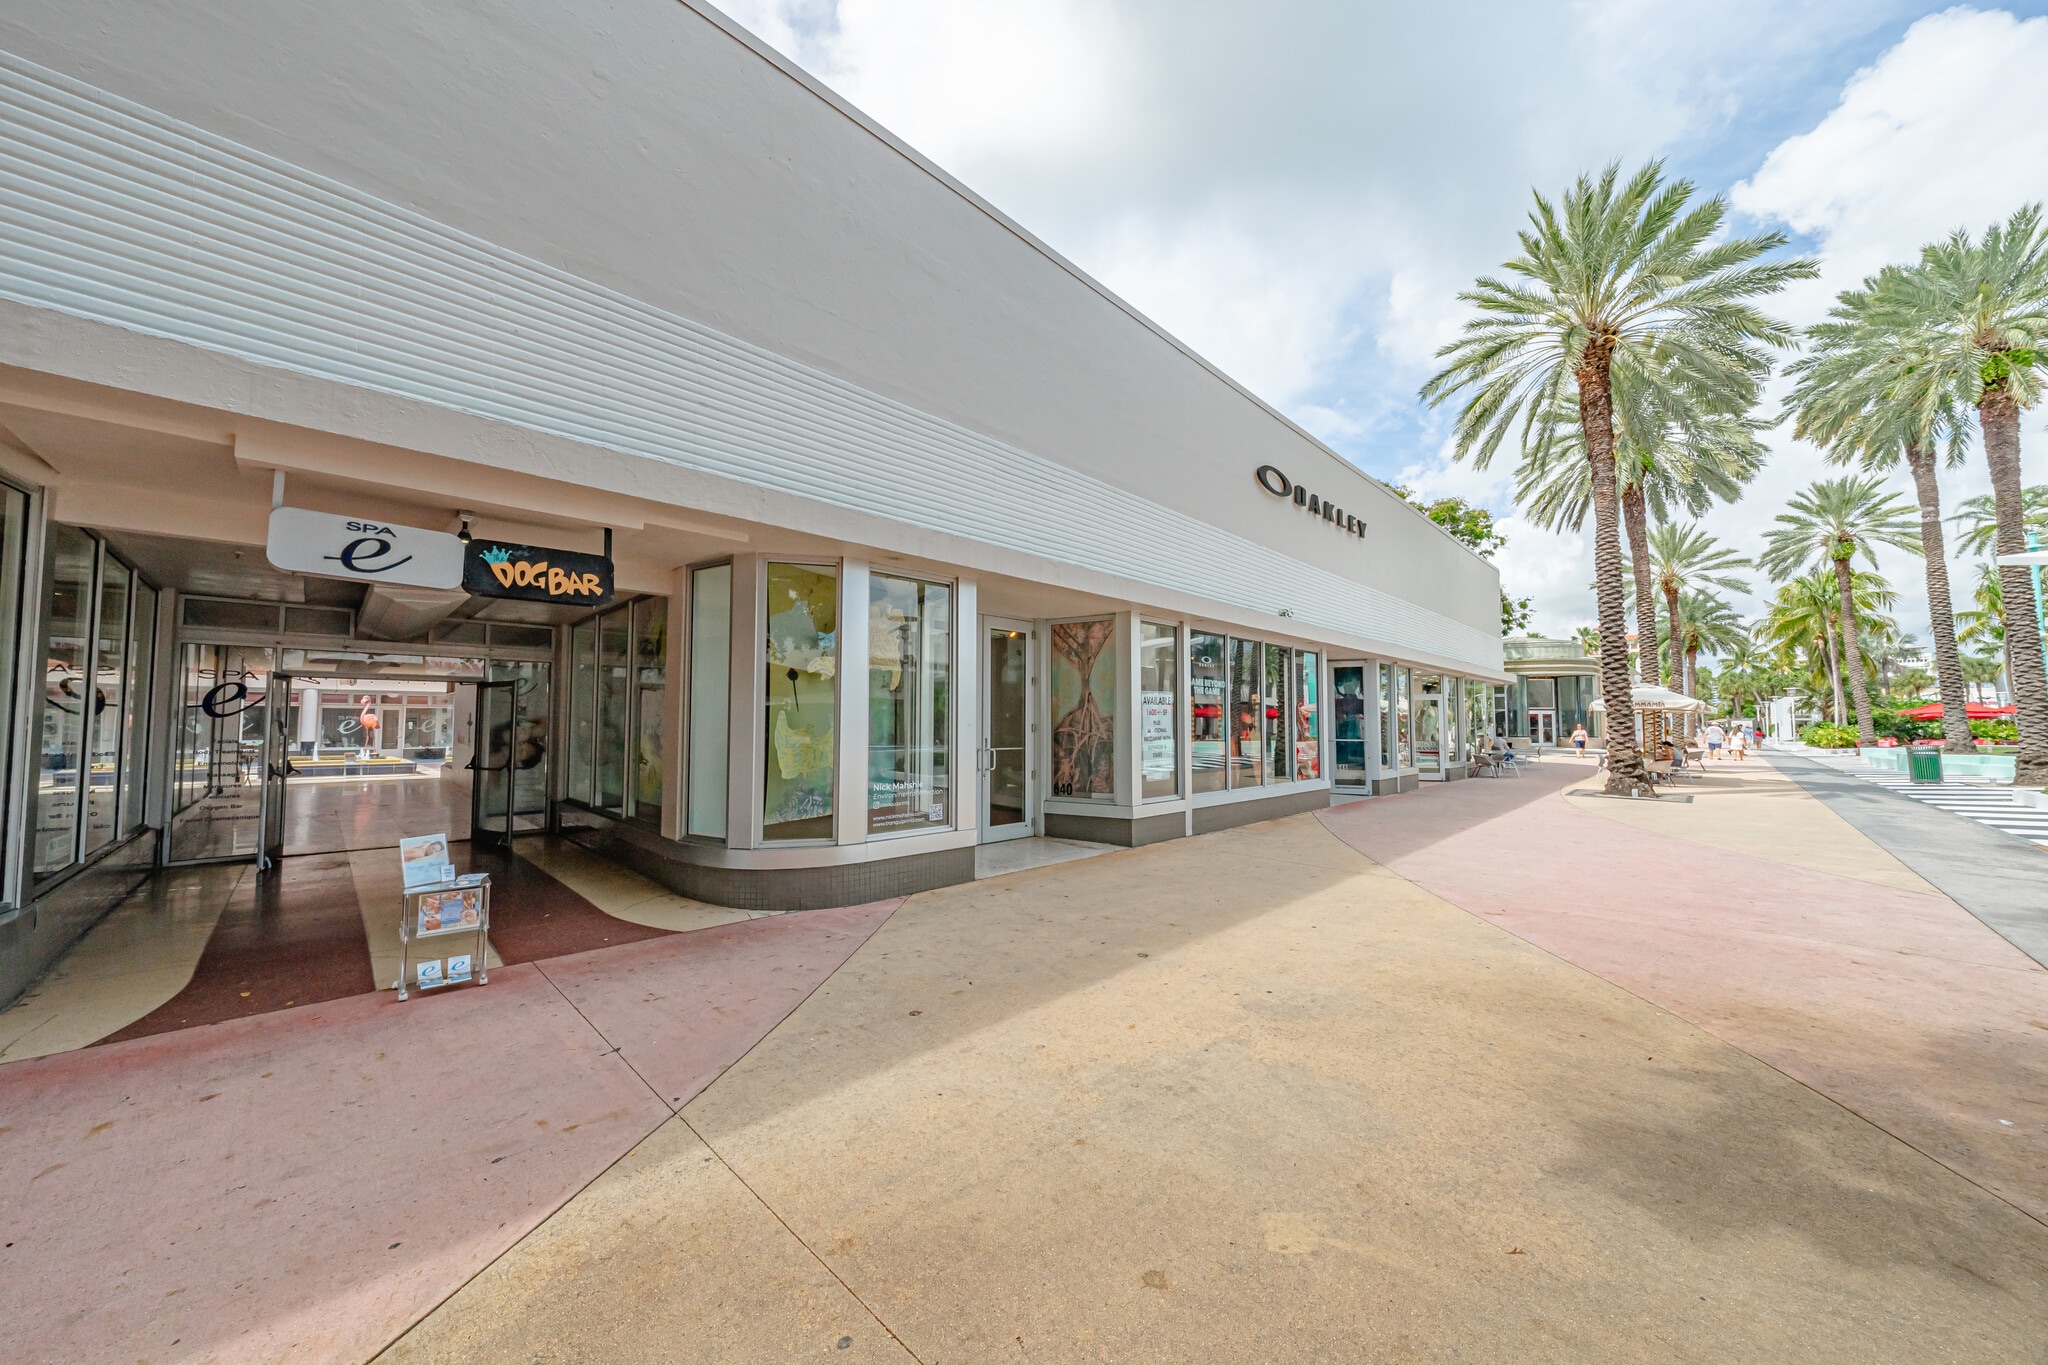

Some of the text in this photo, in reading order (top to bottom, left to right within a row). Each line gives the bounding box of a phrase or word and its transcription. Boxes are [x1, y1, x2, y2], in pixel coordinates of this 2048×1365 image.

[1293, 485, 1367, 539] OAKLEY
[346, 521, 397, 538] SPA
[323, 538, 413, 574] e
[490, 561, 604, 596] DOG BAR
[198, 669, 259, 681] SPA
[1204, 679, 1226, 688] BEYOND
[1193, 686, 1221, 695] THE GAME
[1142, 696, 1172, 706] AVAILABLE
[873, 783, 891, 791] Nick
[199, 804, 228, 812] Oxygen
